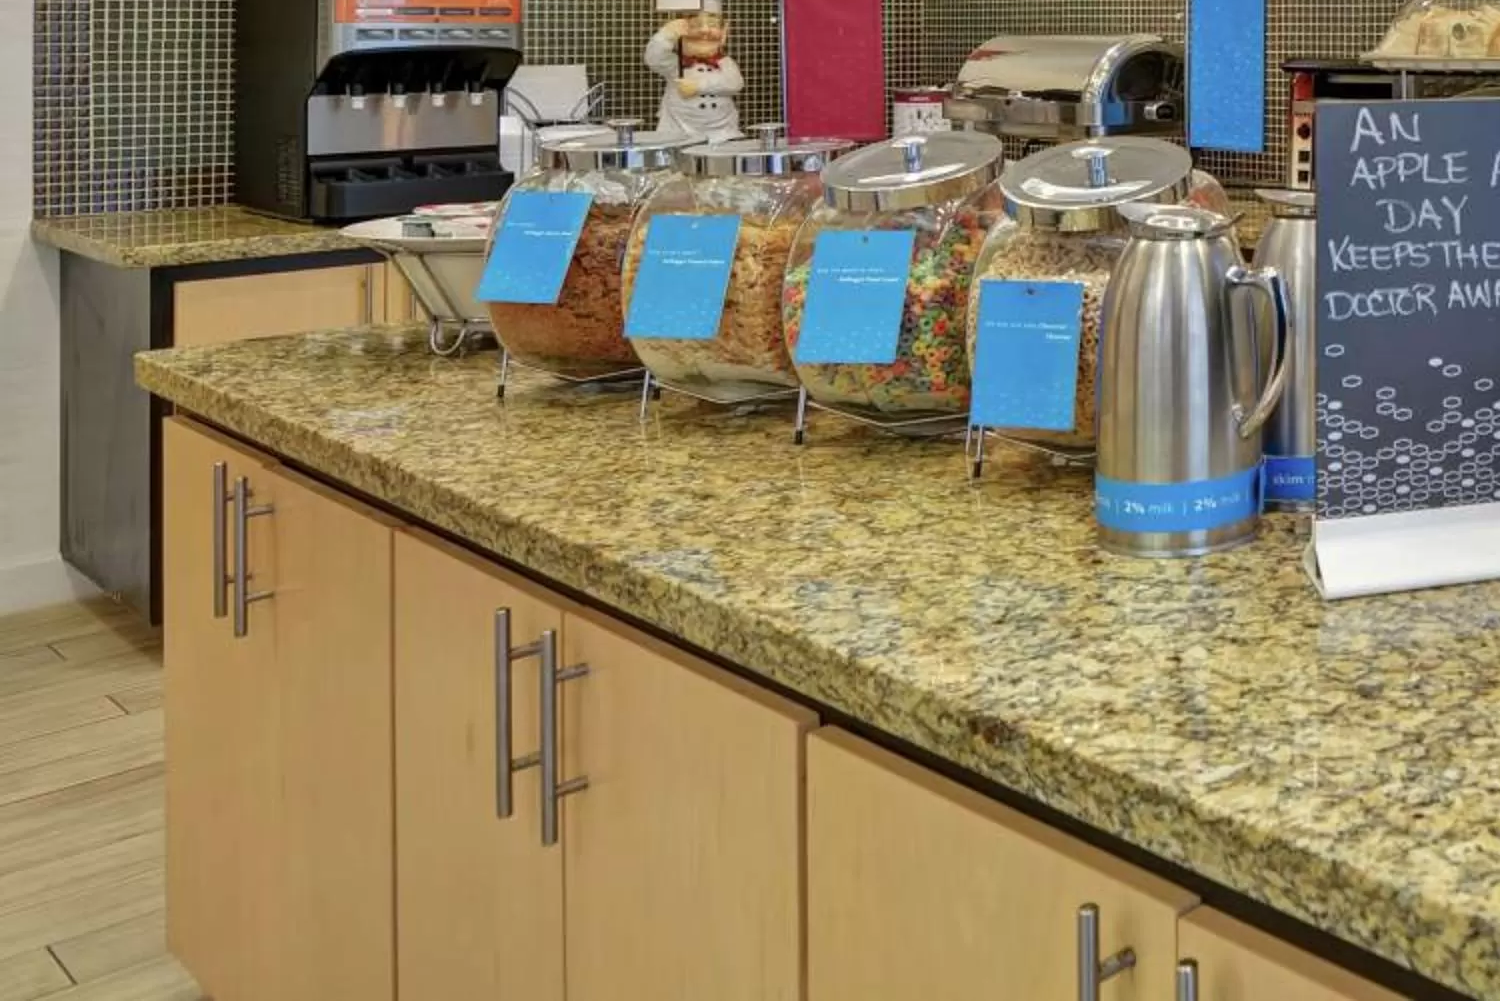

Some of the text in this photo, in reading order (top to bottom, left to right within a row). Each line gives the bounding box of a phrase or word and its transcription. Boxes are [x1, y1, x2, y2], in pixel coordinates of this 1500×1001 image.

[1350, 107, 1421, 152] AN
[1350, 151, 1469, 190] APPLE
[1376, 195, 1469, 235] DAY
[1327, 235, 1429, 272] KEEPS
[1325, 284, 1438, 321] DOCTOR
[1273, 473, 1303, 486] skim
[1123, 499, 1146, 516] 2%
